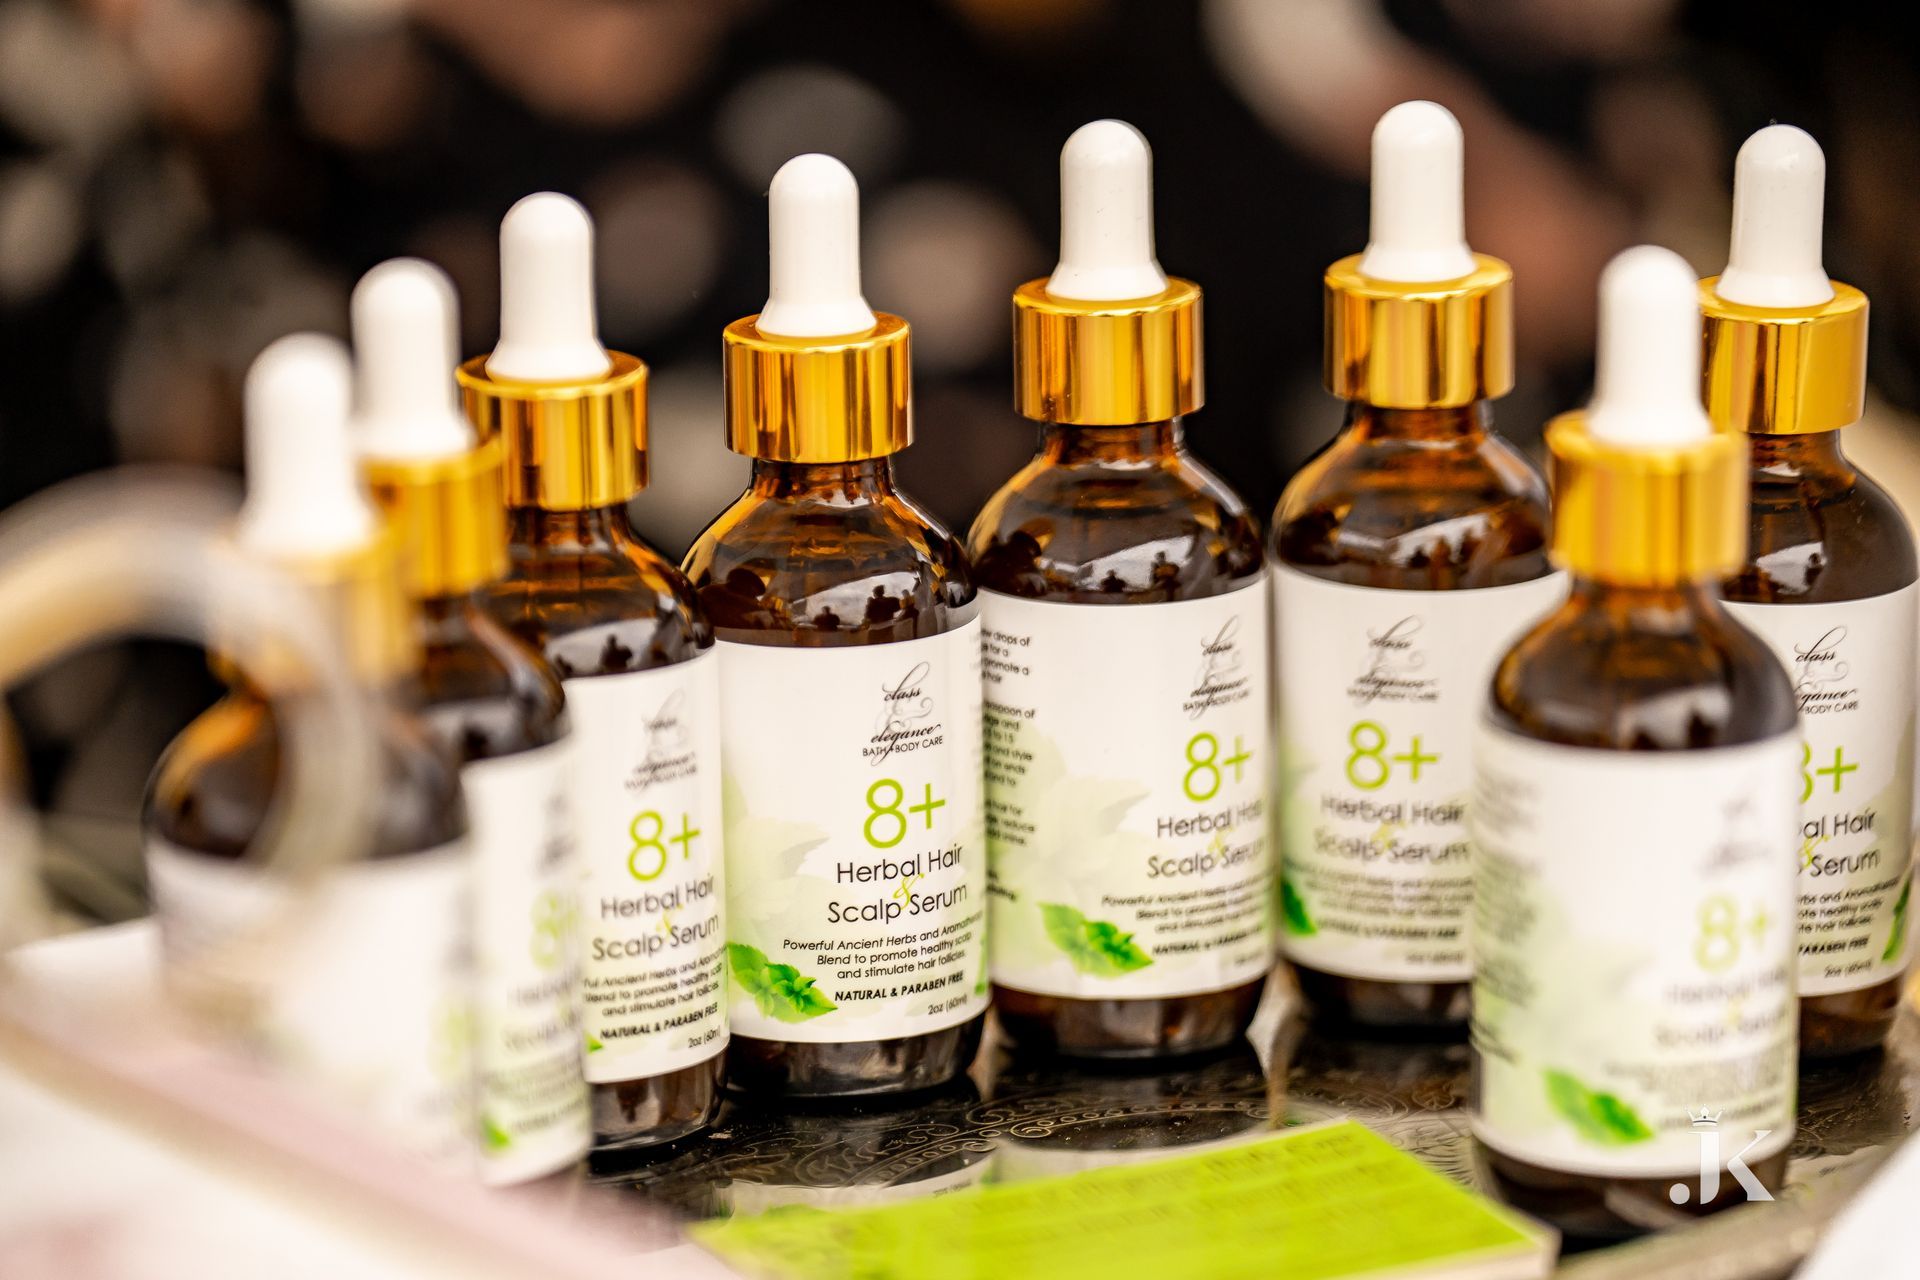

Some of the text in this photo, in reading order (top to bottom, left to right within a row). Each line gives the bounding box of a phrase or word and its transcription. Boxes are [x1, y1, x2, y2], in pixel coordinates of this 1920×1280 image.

[1020, 636, 1031, 647] of
[882, 661, 930, 701] class
[1022, 667, 1030, 676] a
[1024, 709, 1035, 719] of
[870, 720, 941, 766] elegance
[895, 741, 919, 753] BODY
[922, 735, 943, 749] CARE
[1345, 720, 1441, 790] 8+
[1183, 731, 1253, 803] 8+
[863, 778, 946, 849] 8+
[1156, 809, 1232, 838] Herbal
[1833, 806, 1877, 837] Hair
[627, 810, 702, 882] 8+
[837, 843, 962, 883] Herbal Hair
[1147, 854, 1215, 879] Scalp
[1810, 848, 1880, 878] Serum
[600, 884, 681, 919] Herbal
[827, 902, 902, 924] Scalp
[909, 885, 967, 916] Serum
[592, 914, 720, 961] Scalp Serum
[782, 939, 835, 951] Powerful
[837, 938, 884, 951] Ancient
[886, 934, 918, 948] Herbs
[919, 928, 940, 942] and
[816, 954, 852, 966] Blend
[854, 953, 868, 964] to
[869, 948, 919, 966] promote
[920, 940, 955, 956] healthy
[836, 968, 862, 980] and
[864, 962, 916, 979] stimulate
[917, 957, 937, 971] hair
[834, 969, 964, 1002] NATURAL & PARABEN FREE
[927, 1005, 944, 1016] 2oz
[600, 1023, 651, 1040] NATURAL
